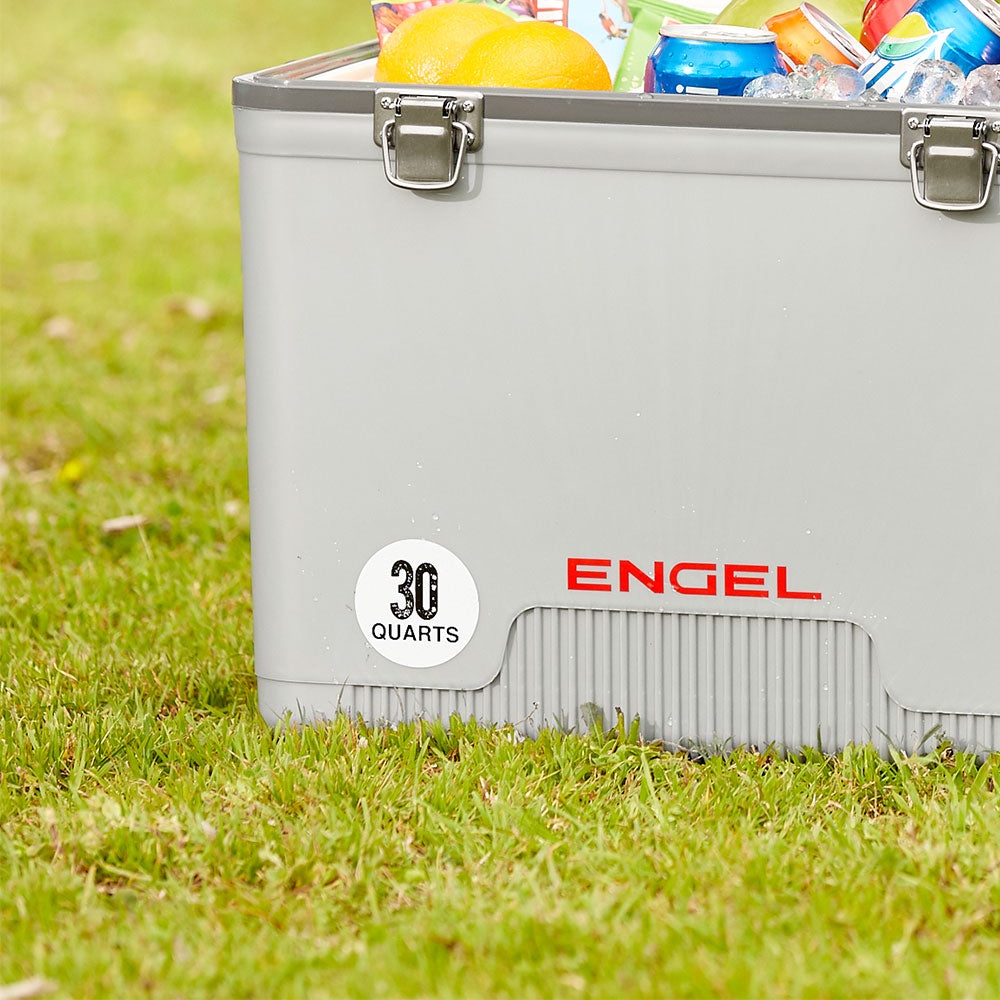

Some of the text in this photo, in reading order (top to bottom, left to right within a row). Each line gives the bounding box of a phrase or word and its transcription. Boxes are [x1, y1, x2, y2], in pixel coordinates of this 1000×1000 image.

[390, 559, 439, 620] 30
[567, 558, 822, 600] ENGEL
[371, 622, 459, 643] QUARTS
